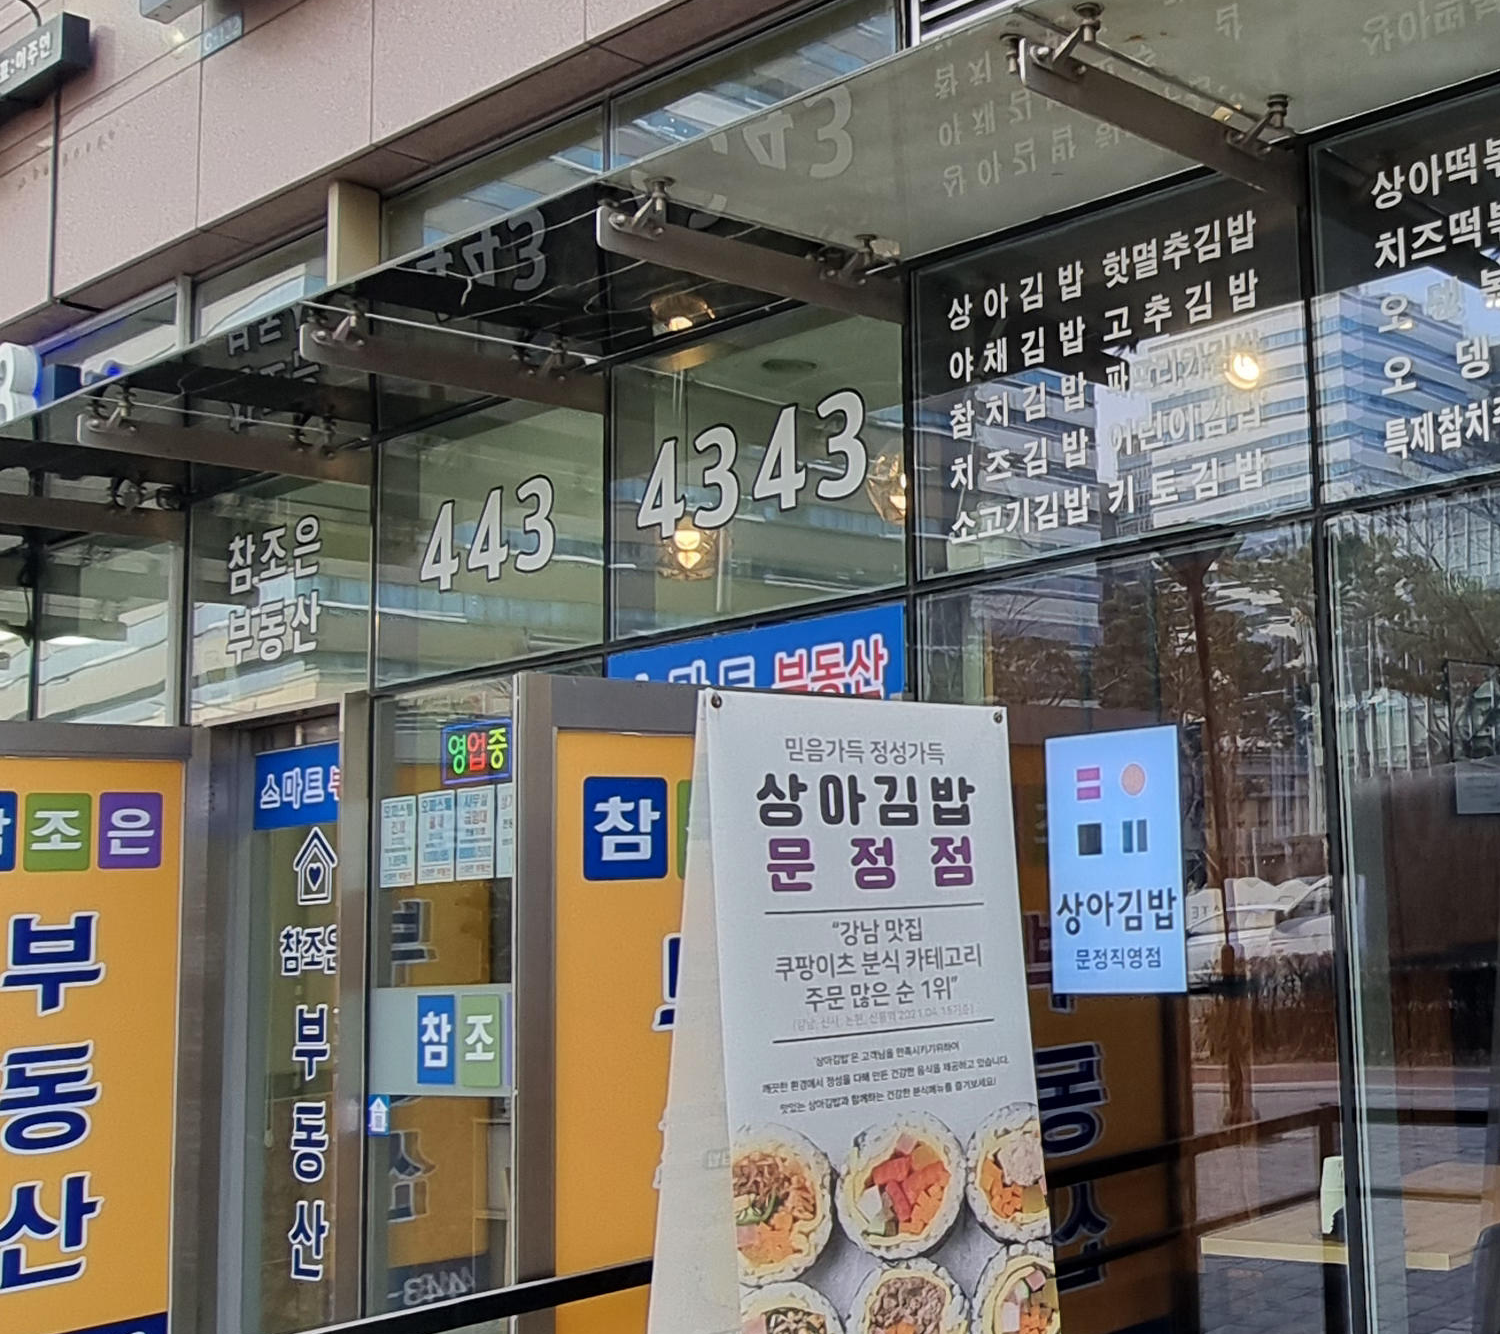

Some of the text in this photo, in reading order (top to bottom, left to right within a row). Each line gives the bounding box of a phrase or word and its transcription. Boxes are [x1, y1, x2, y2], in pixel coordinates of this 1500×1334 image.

[947, 210, 1257, 332] 상아김밥 핫멸추김밥
[950, 269, 1258, 384] 야채김밥 고추김밥
[950, 371, 1088, 441] 참치김밥
[419, 387, 869, 593] 443 4343
[950, 428, 1089, 492] 치즈김밥
[950, 448, 1265, 545] 소고기김밥 키토김밥
[227, 515, 323, 596] 참조은
[225, 591, 322, 666] 부동산
[447, 726, 508, 775] 영업중
[784, 737, 946, 766] 믿음가득 정성가득
[260, 767, 325, 810] 스마트
[755, 772, 977, 828] 상아김밥
[0, 803, 156, 863] 조은
[593, 796, 661, 863] 참
[765, 835, 976, 893] 문정점
[885, 917, 923, 944] 맛집
[1056, 887, 1178, 935] 상아김밥
[775, 943, 983, 982] 쿠팡이츠 분식 카테고리
[1074, 946, 1162, 971] 문정직영점
[805, 986, 846, 1013] 주문
[850, 981, 891, 1009] 많은
[895, 979, 916, 1005] 순
[0, 912, 105, 1293] 부동산
[288, 1004, 331, 1284] 부동산
